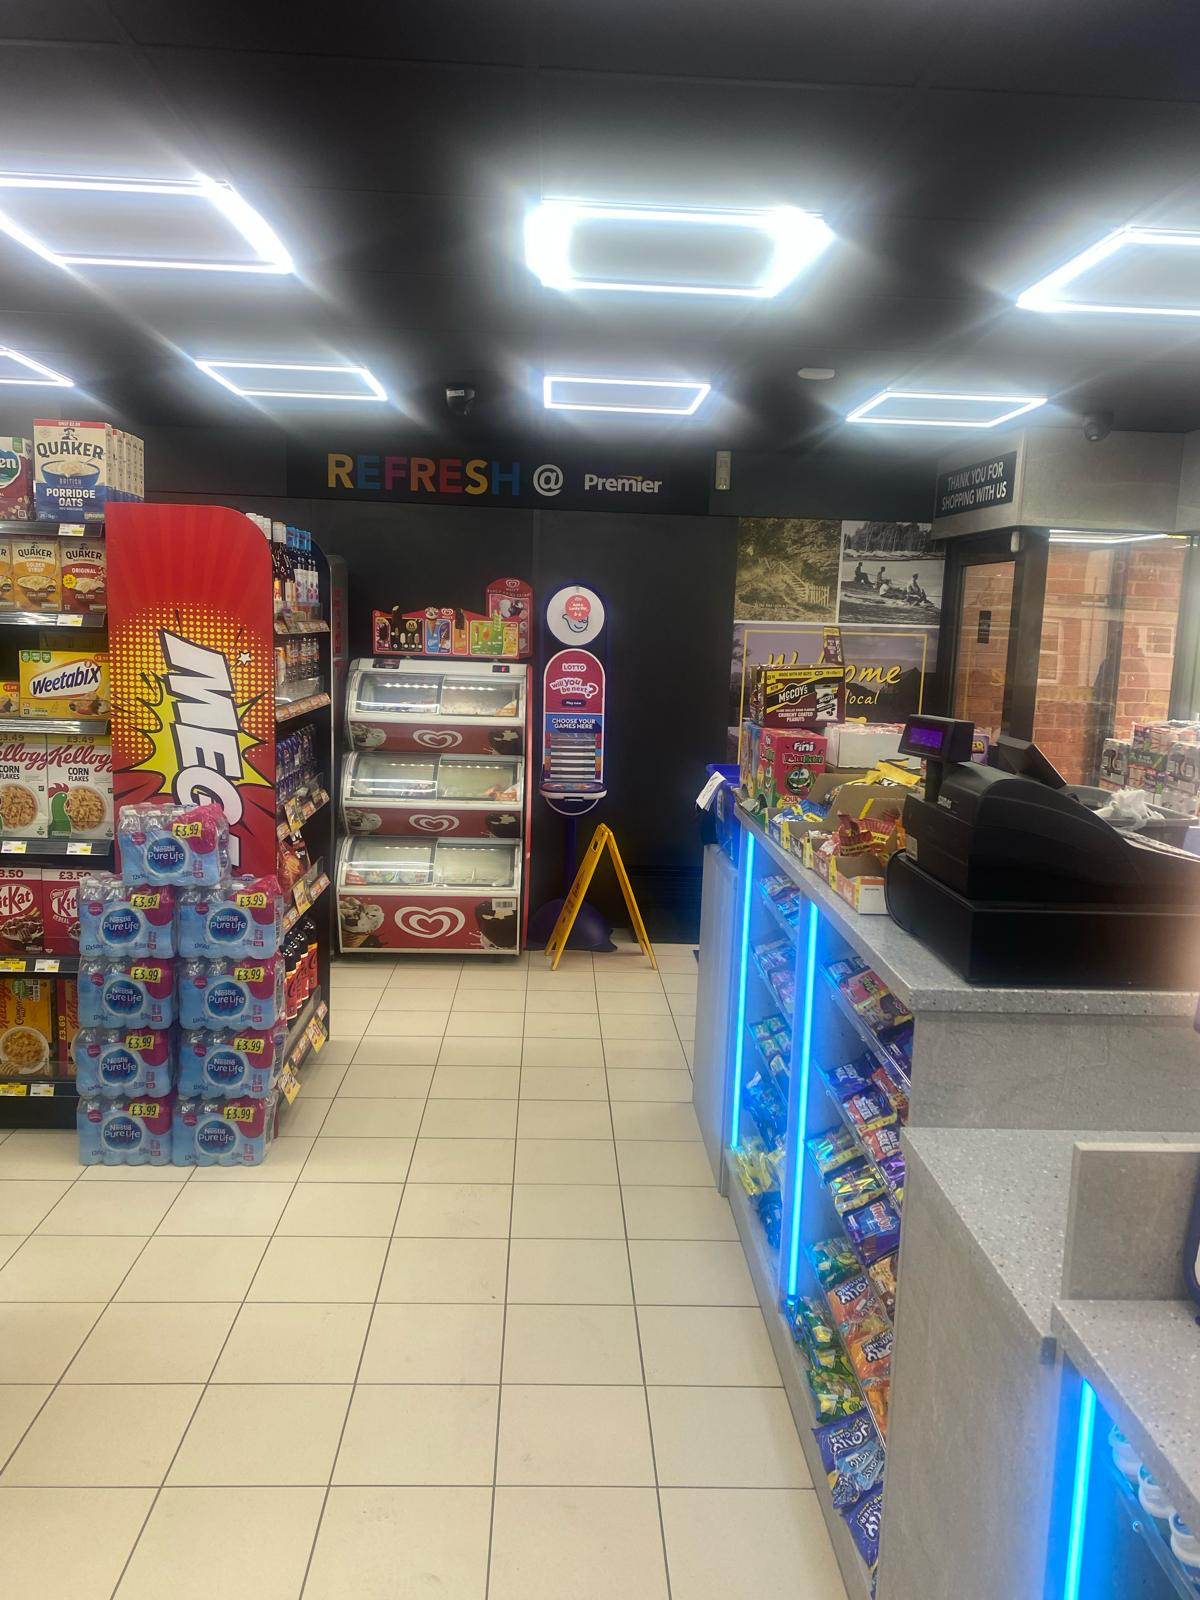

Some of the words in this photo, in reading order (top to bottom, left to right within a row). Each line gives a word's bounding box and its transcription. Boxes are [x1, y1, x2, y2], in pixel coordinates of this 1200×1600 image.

[36, 440, 105, 460] QUAKER
[326, 453, 520, 496] REFRESH
[533, 463, 564, 497] @
[584, 474, 663, 494] Premier
[947, 472, 970, 491] THANK
[971, 466, 987, 485] YOU
[988, 461, 1004, 480] FOR
[46, 487, 96, 499] PORRIDGE
[941, 489, 975, 511] SHOPPING
[976, 484, 995, 503] WITH
[996, 480, 1007, 498] US
[58, 498, 84, 507] OATS
[17, 548, 53, 558] QUAKER
[65, 550, 103, 560] QUAKER
[32, 665, 102, 695] Weetabix
[564, 678, 581, 688] you
[845, 690, 880, 705] local
[793, 740, 815, 752] fini
[0, 765, 20, 773] CORN
[68, 767, 90, 776] CORN
[174, 823, 200, 838] £3.99
[148, 852, 168, 860] Pure
[169, 852, 184, 862] Life
[0, 869, 24, 878] 3.50
[0, 886, 31, 916] itKat
[132, 895, 158, 908] £3.99
[238, 894, 264, 907] £3.99
[103, 922, 124, 930] Pure
[124, 922, 140, 932] Life
[210, 922, 230, 930] Pure
[231, 921, 248, 932] Life
[133, 968, 159, 982] £3.99
[236, 968, 262, 981] £3.99
[105, 993, 127, 1001] Pure
[126, 993, 142, 1004] Life
[208, 995, 228, 1004] Pure
[229, 994, 245, 1005] Life
[58, 1015, 66, 1040] £3.69
[127, 1036, 152, 1049] £3.99
[236, 1039, 262, 1052] £3.99
[101, 1062, 122, 1072] Pure
[122, 1062, 137, 1072] Life
[208, 1064, 229, 1072] Pure
[229, 1063, 244, 1074] Life
[131, 1104, 156, 1116] £3.99
[226, 1108, 251, 1120] £3.99
[104, 1130, 126, 1138] Pure
[126, 1130, 142, 1140] Life
[198, 1134, 219, 1142] Pure
[219, 1133, 234, 1144] Life
[832, 1423, 871, 1454] JOLLY
